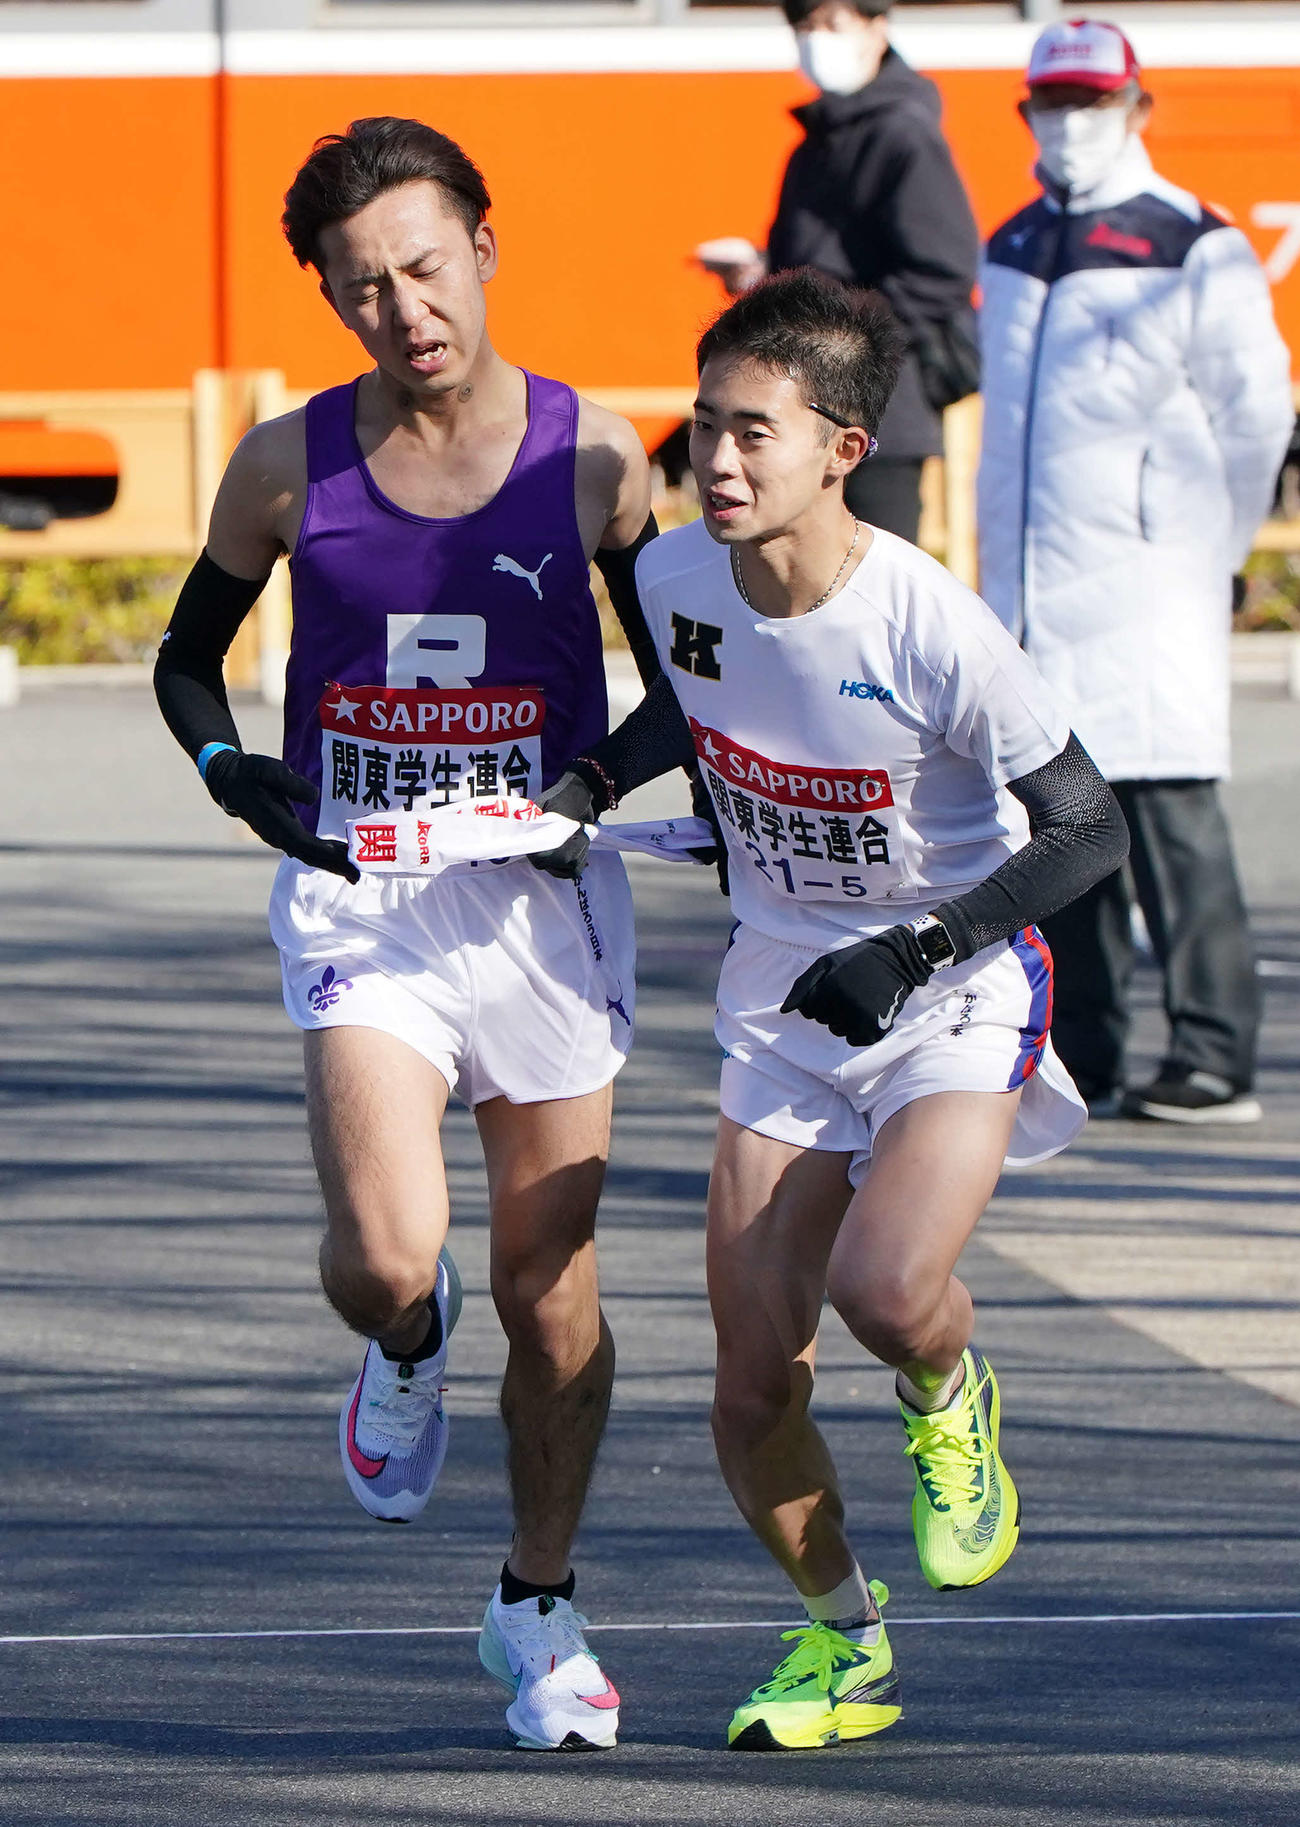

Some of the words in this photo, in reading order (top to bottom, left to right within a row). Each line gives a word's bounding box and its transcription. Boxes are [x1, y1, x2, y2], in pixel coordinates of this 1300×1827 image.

[386, 613, 486, 689] R
[670, 611, 723, 682] K
[369, 700, 538, 734] SAPPORO
[839, 679, 895, 704] HOKA
[331, 738, 532, 812] 関東学生連合
[728, 752, 887, 804] SAPPORO
[354, 823, 397, 862] 関
[707, 768, 890, 866] 関東学生連合
[745, 841, 868, 898] 21-5
